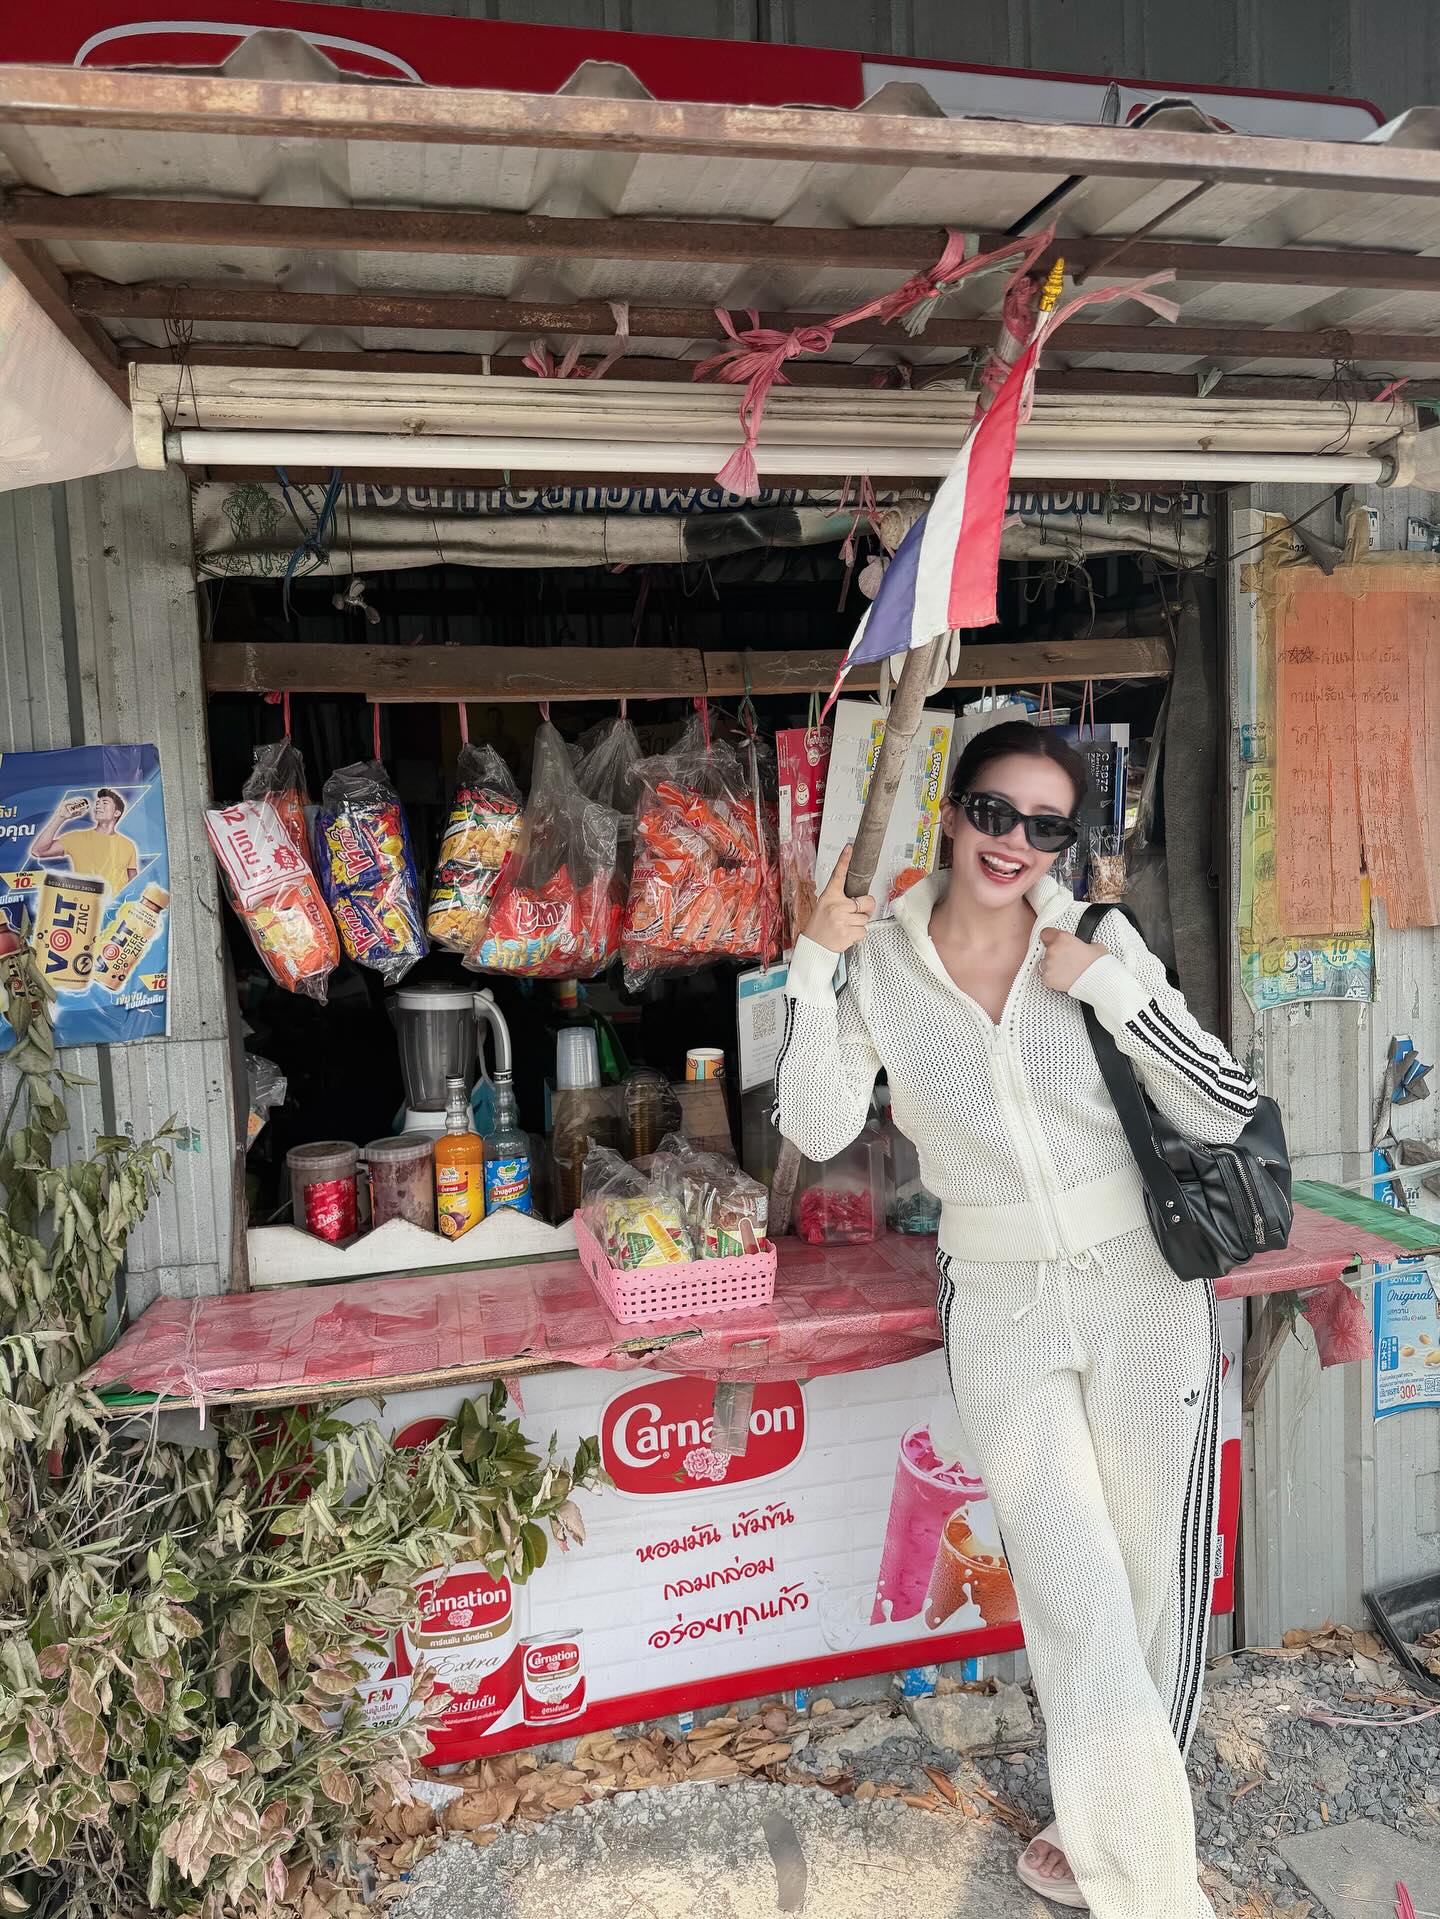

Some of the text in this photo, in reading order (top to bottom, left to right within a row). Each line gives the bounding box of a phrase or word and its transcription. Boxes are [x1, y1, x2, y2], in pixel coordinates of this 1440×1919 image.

[927, 752, 943, 802] PUSH POP
[918, 830, 932, 855] PUSH
[45, 893, 90, 974] VOLT ZINC
[112, 932, 142, 971] BOOSTER
[1331, 939, 1350, 955] 10
[1331, 954, 1348, 963] บาท
[1344, 987, 1368, 999] AJE
[1387, 1287, 1434, 1306] Original
[1400, 1384, 1417, 1399] 300
[612, 1403, 797, 1468] Carnaon
[636, 1501, 795, 1563] หอมมัน เข้มข้น
[663, 1555, 775, 1601] กลมกล่อม
[648, 1581, 809, 1649] อร่อยทุกแก้ว
[424, 1653, 502, 1676] Extra
[527, 1650, 578, 1669] Carnation
